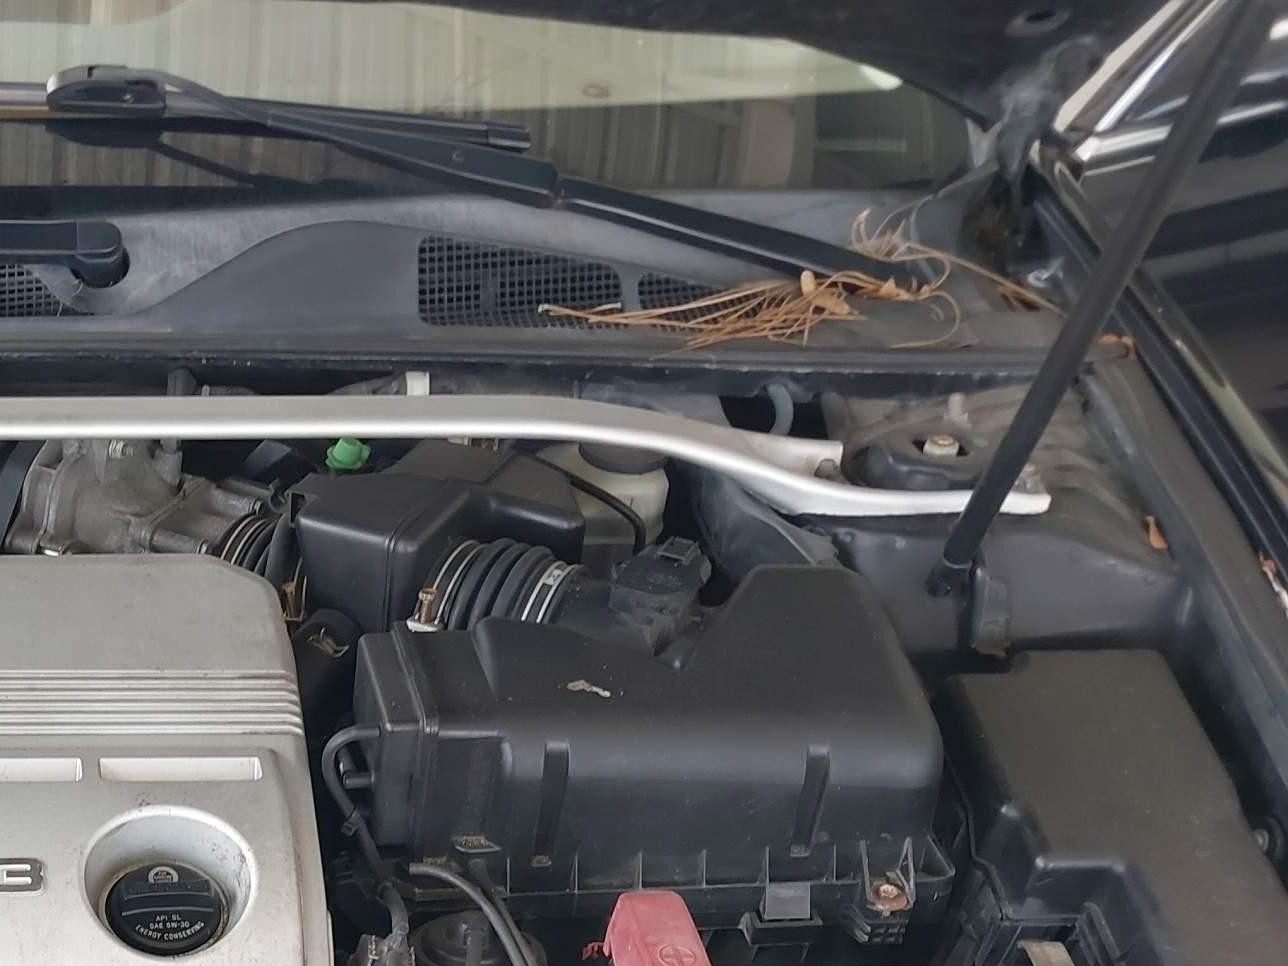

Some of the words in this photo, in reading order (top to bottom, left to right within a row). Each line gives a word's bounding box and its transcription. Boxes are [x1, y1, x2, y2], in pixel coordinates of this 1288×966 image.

[135, 924, 162, 939] ENERGY
[164, 921, 205, 940] CONSERVING
[166, 921, 190, 929] 5W-30
